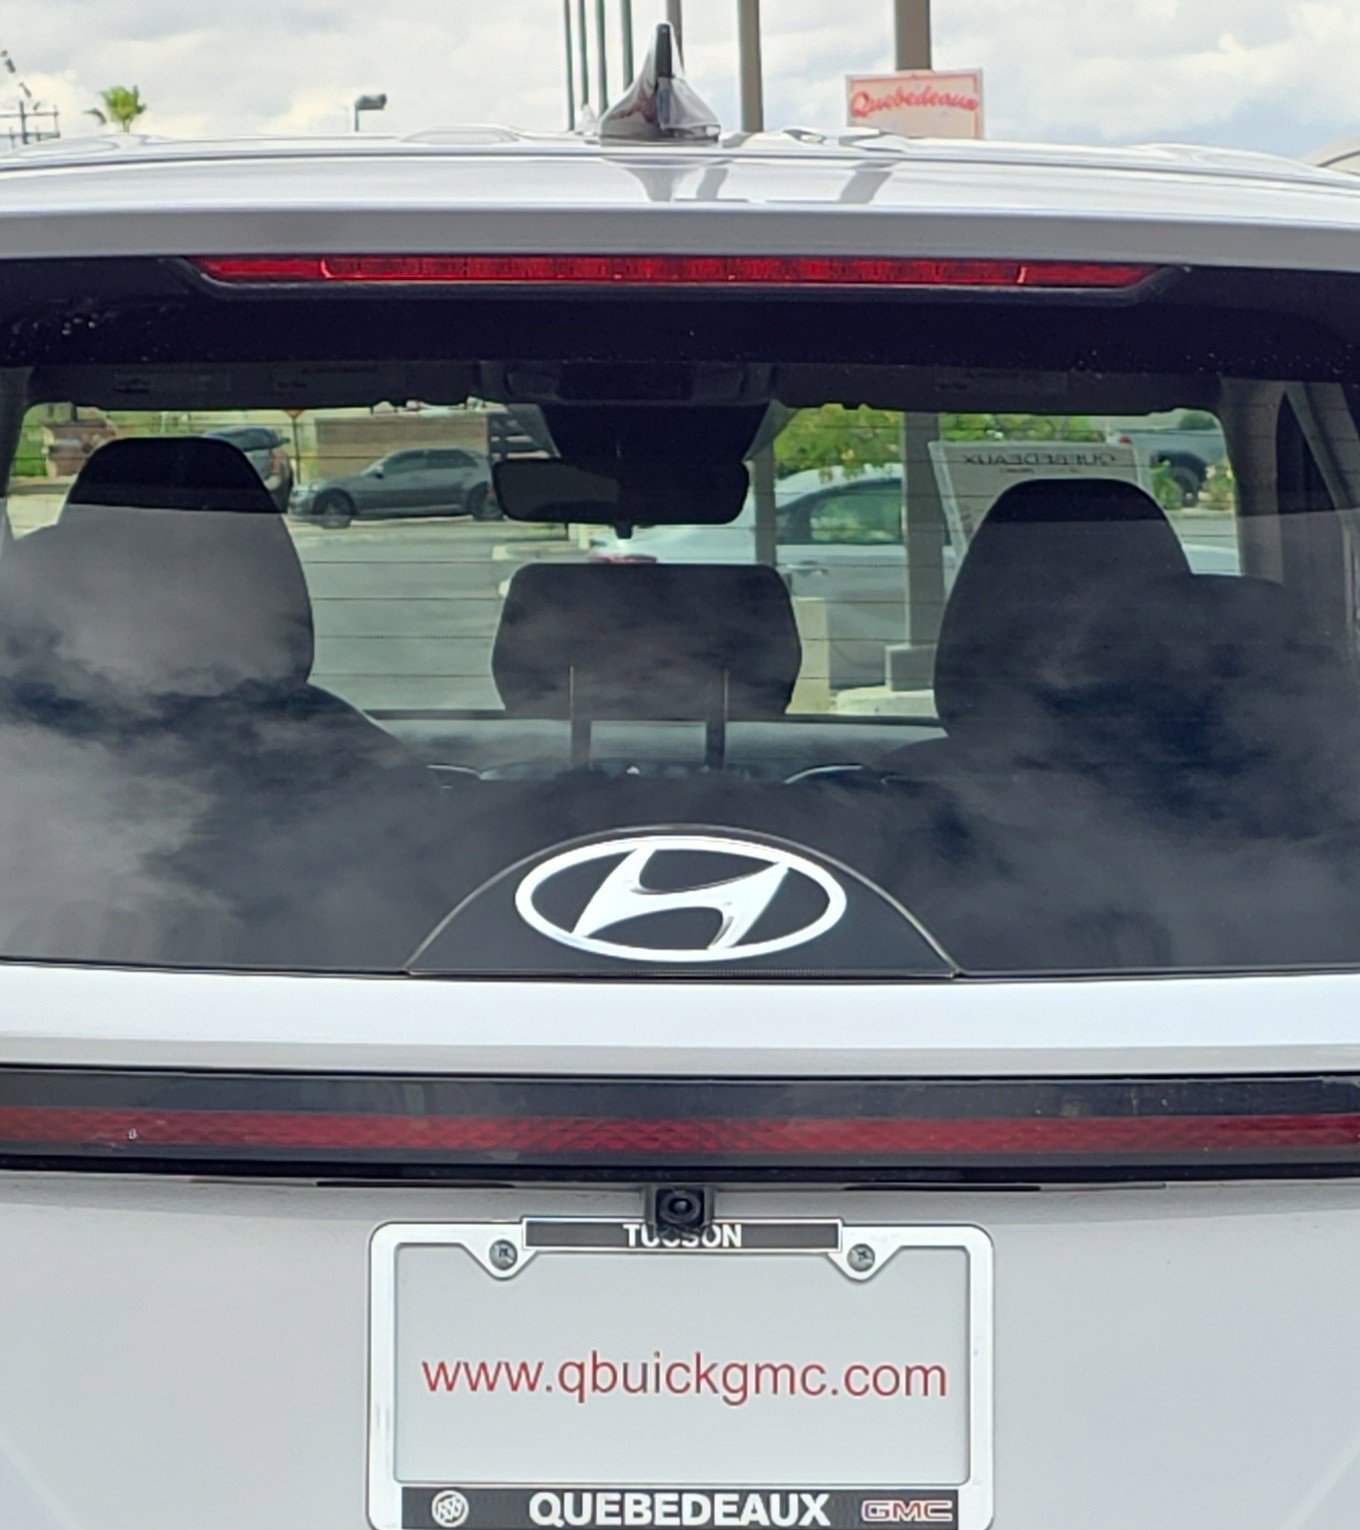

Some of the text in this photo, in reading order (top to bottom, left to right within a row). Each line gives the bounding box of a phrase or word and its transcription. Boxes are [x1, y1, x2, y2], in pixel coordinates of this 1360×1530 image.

[421, 1350, 947, 1406] www.qbuickgmc.com
[528, 1492, 953, 1528] QUEBEDEAUX GMC
